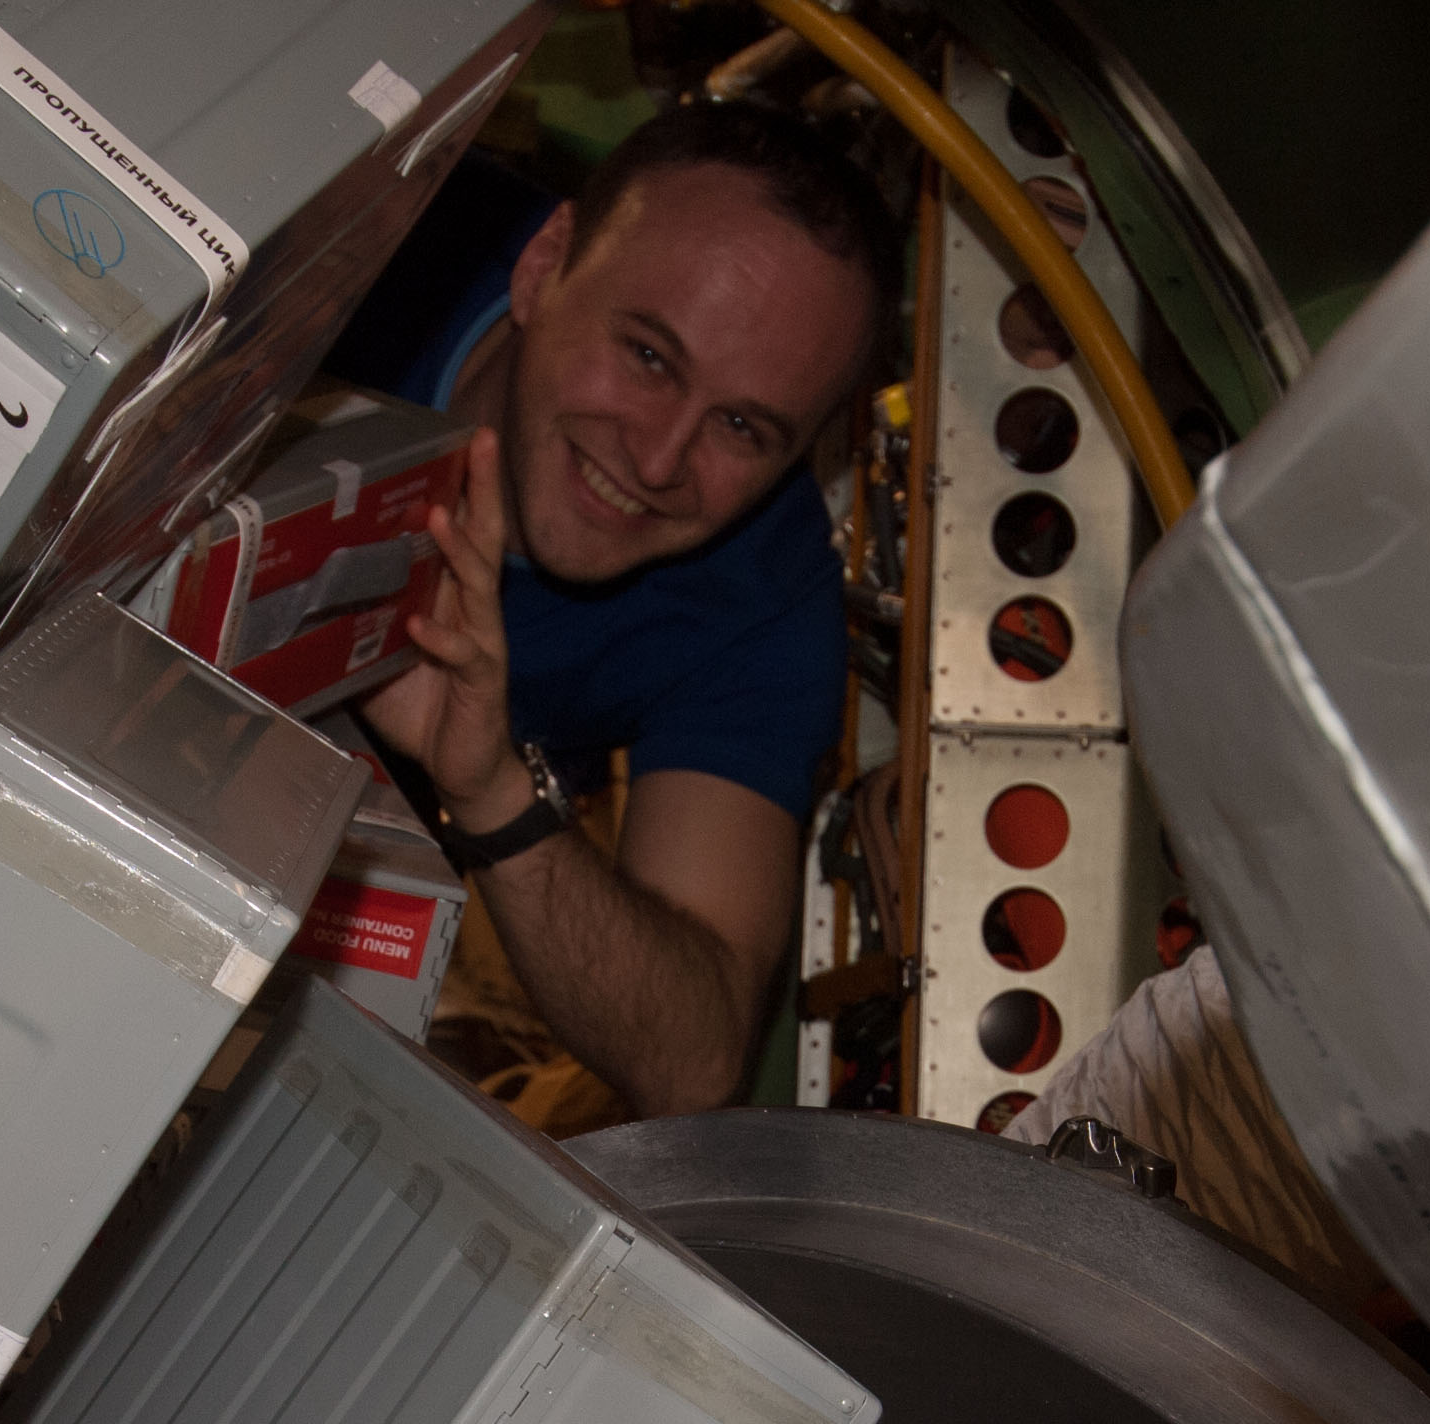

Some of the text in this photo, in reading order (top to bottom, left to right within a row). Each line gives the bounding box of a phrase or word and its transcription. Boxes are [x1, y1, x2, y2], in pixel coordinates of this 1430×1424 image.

[13, 67, 197, 227] ПРОПУЩЕННЫЙ
[312, 926, 412, 960] MENU FOOD
[328, 911, 416, 942] CONTAINER
